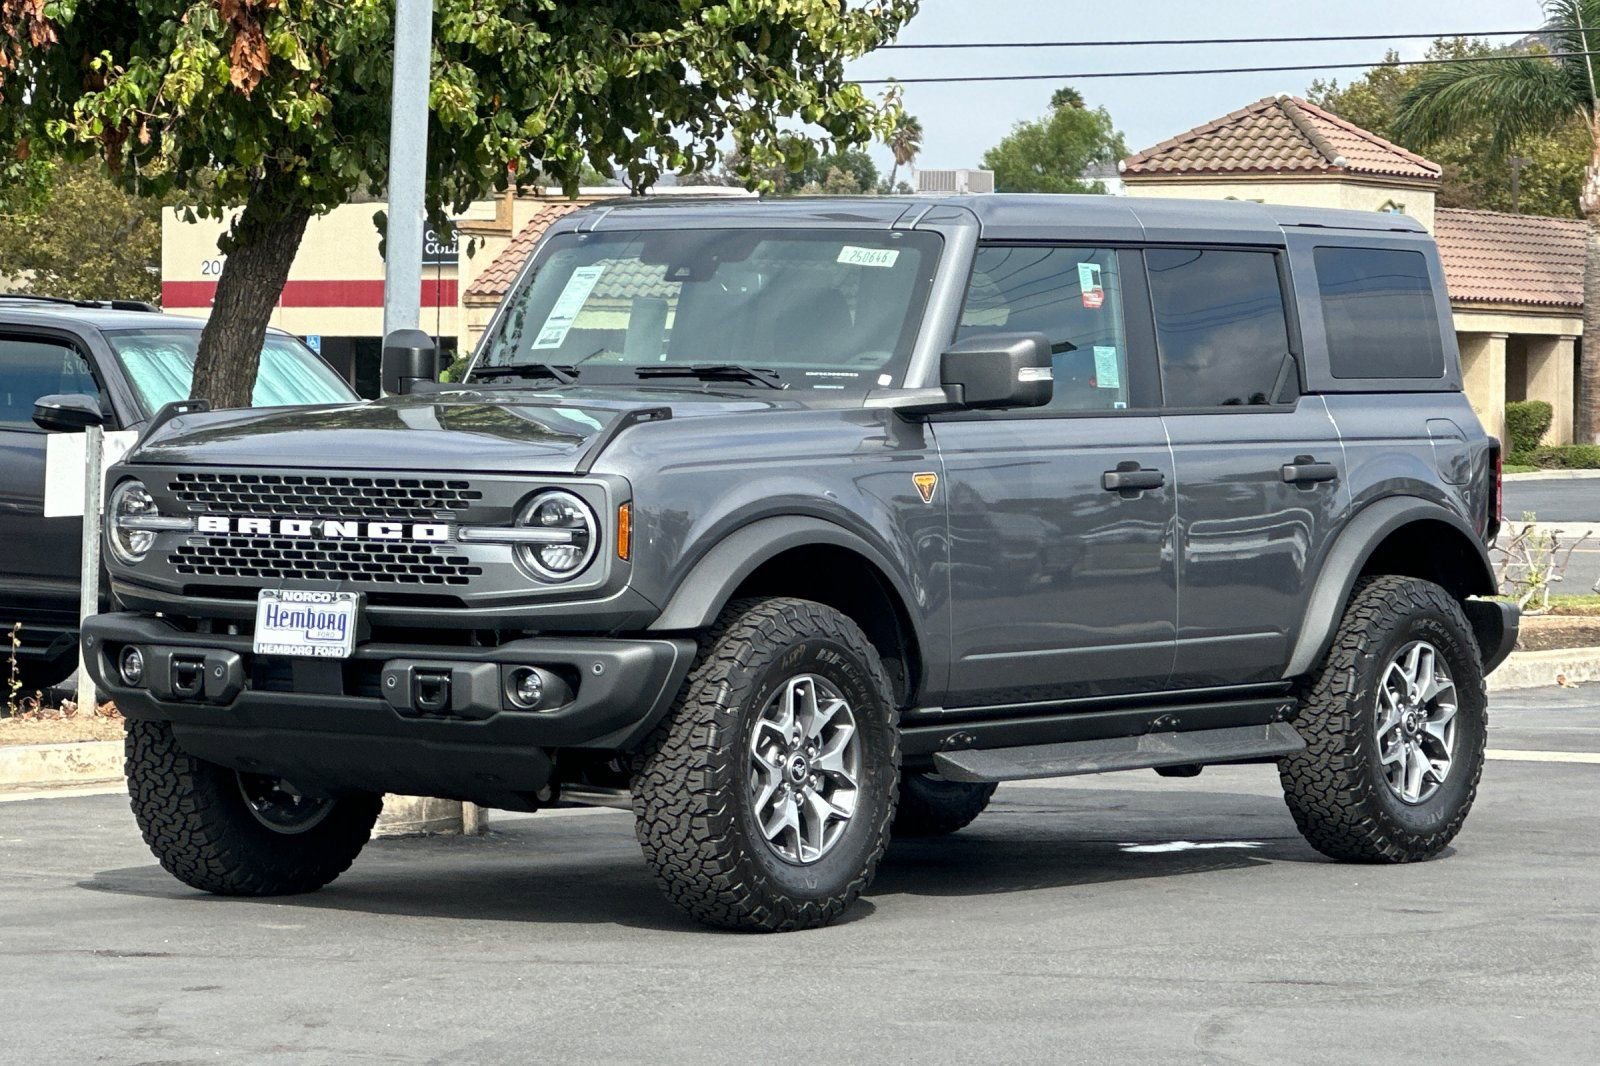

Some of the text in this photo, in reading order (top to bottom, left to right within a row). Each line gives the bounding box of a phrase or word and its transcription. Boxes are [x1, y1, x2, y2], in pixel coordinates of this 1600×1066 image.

[201, 260, 221, 275] 20
[198, 516, 449, 541] BRONCO
[281, 591, 332, 603] NORCO
[265, 603, 347, 641] Hemborg
[258, 643, 344, 657] HEMBORG FORD
